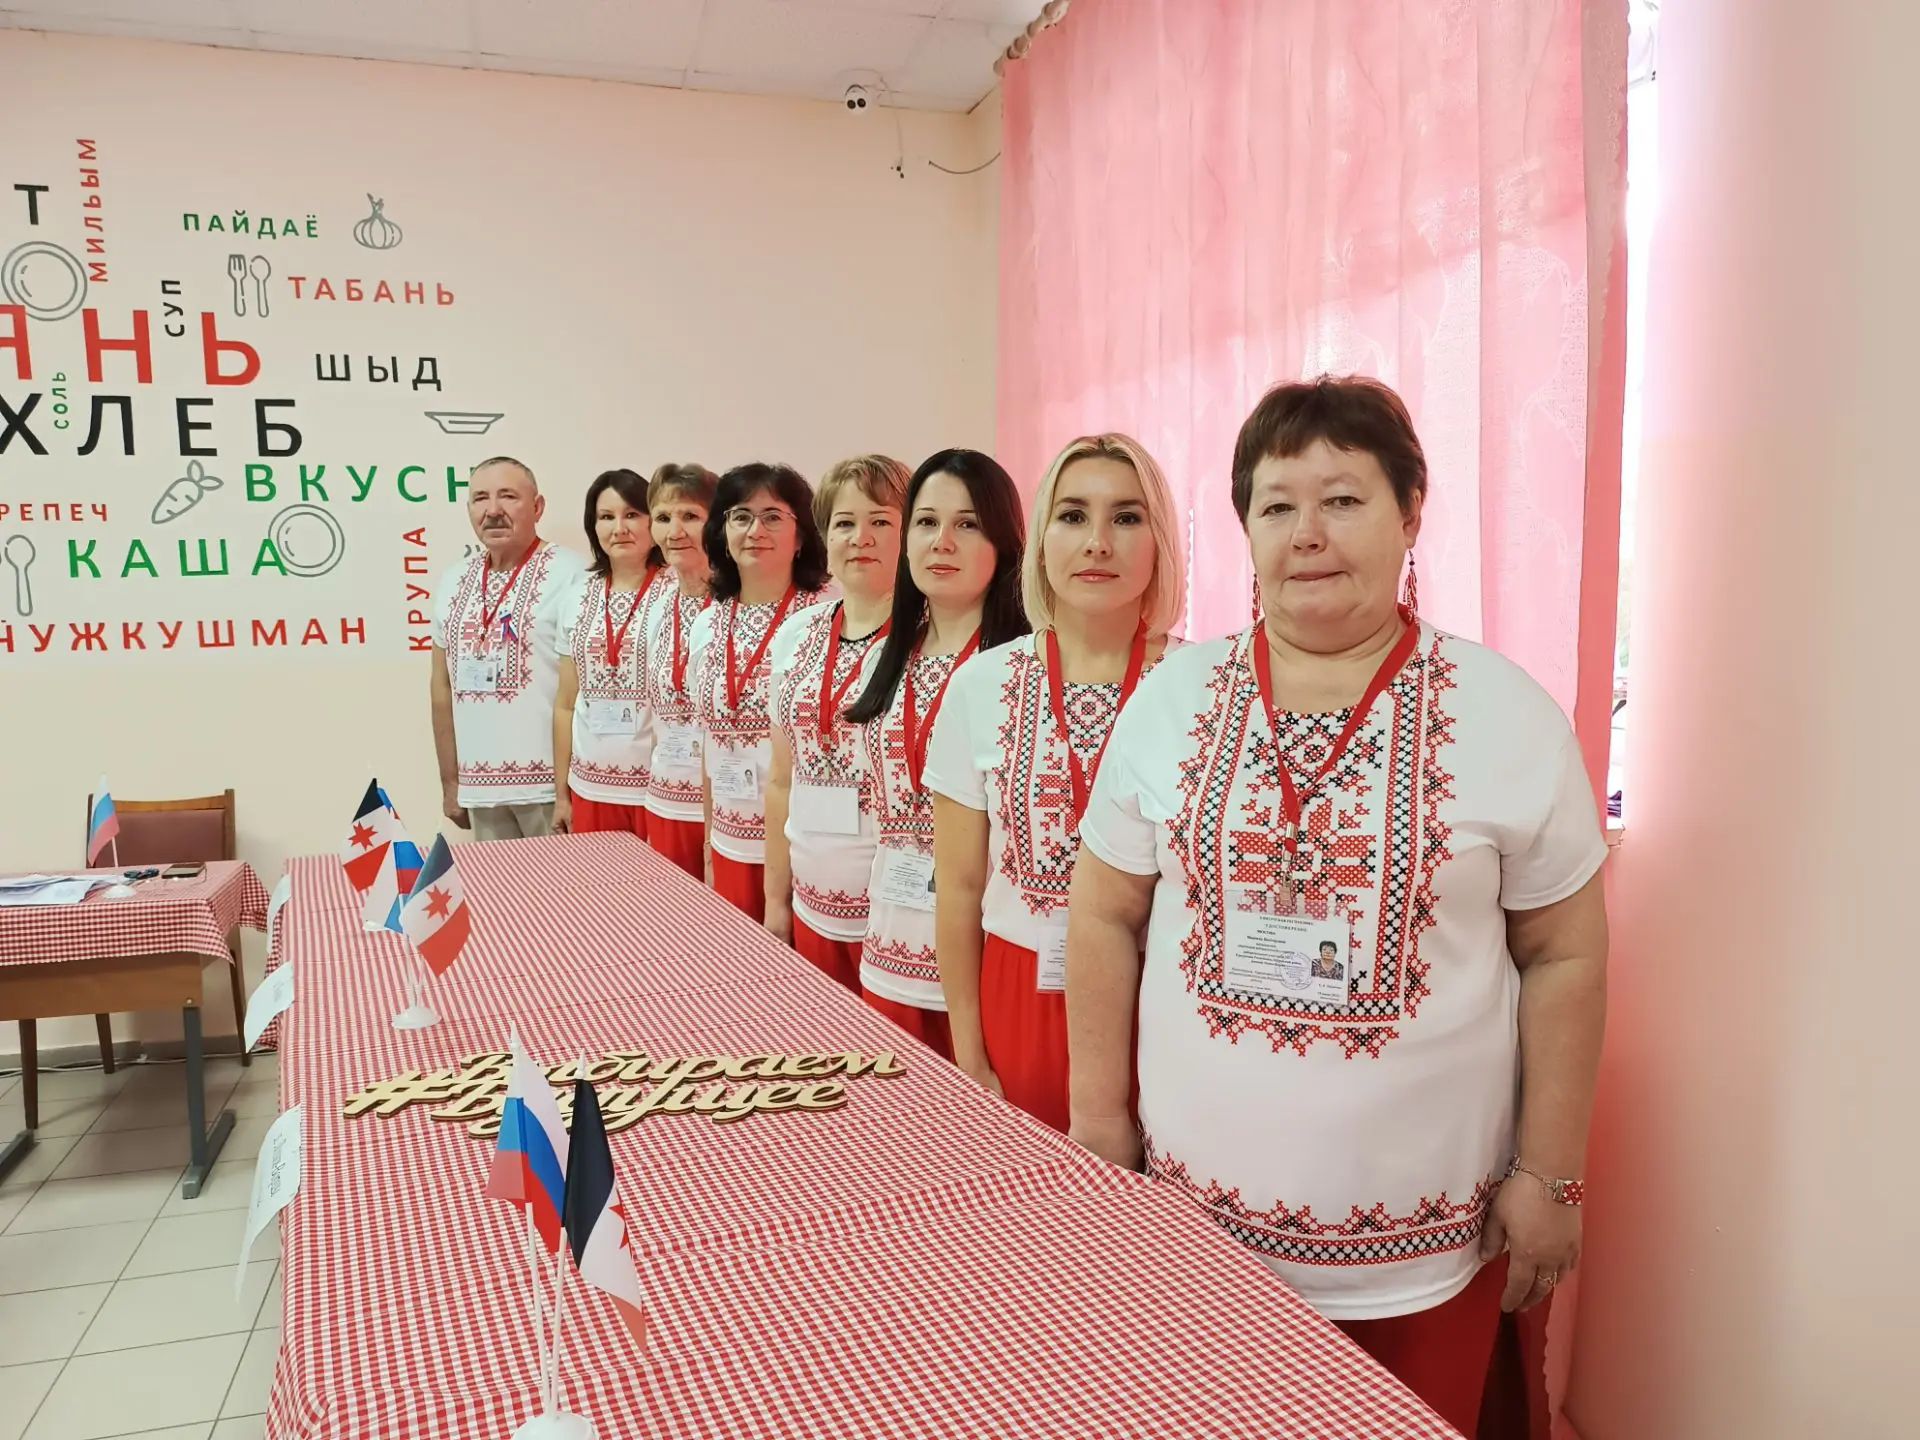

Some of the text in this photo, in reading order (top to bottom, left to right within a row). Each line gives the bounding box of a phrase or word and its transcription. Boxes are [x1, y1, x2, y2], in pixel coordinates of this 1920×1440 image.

[76, 138, 108, 282] МИЛЬЫМ
[183, 211, 319, 240] ПАЙДАЁ
[161, 280, 185, 337] СУП
[288, 276, 456, 306] ТАБАНЬ
[51, 371, 70, 430] СОЛЬ
[315, 353, 442, 391] ШЫД
[0, 392, 303, 457] ХЛЕБ
[67, 538, 288, 578] КАША
[403, 527, 433, 651] КРУПА
